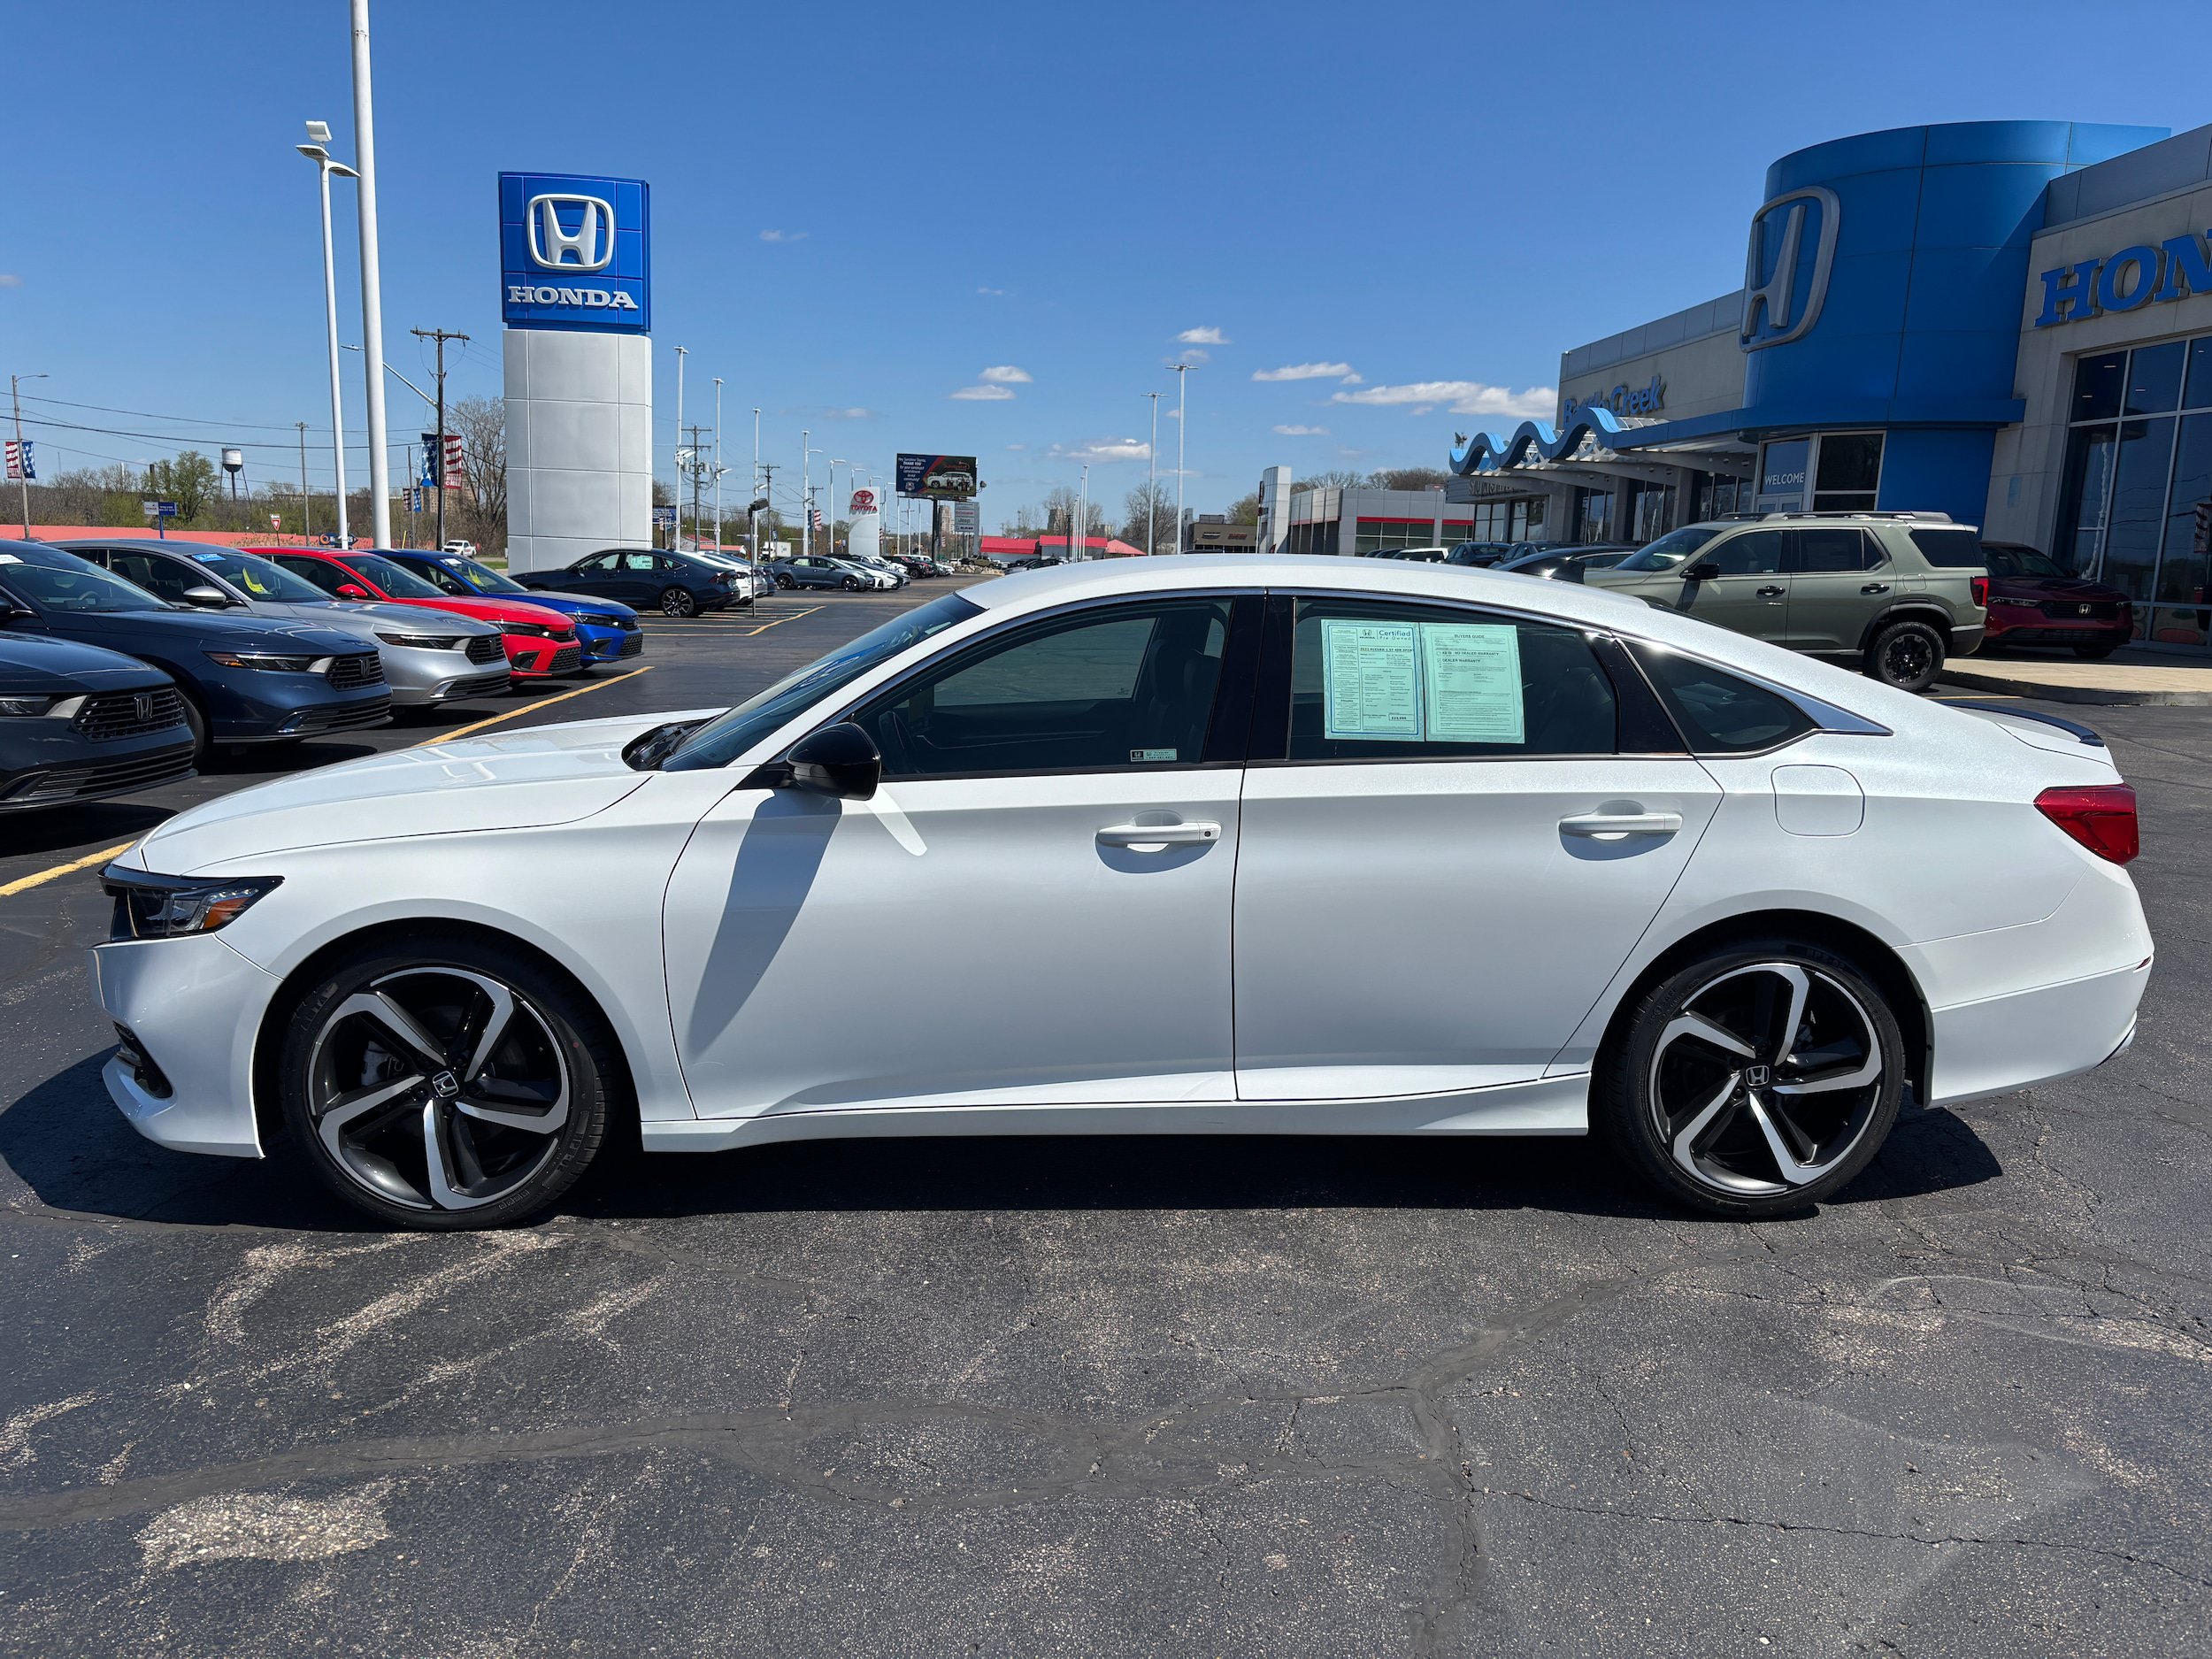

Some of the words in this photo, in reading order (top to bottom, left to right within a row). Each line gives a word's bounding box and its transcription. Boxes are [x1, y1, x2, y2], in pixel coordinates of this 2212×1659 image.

[508, 286, 638, 309] HONDA
[1610, 375, 1662, 416] Creek
[1764, 472, 1805, 486] WELCOME
